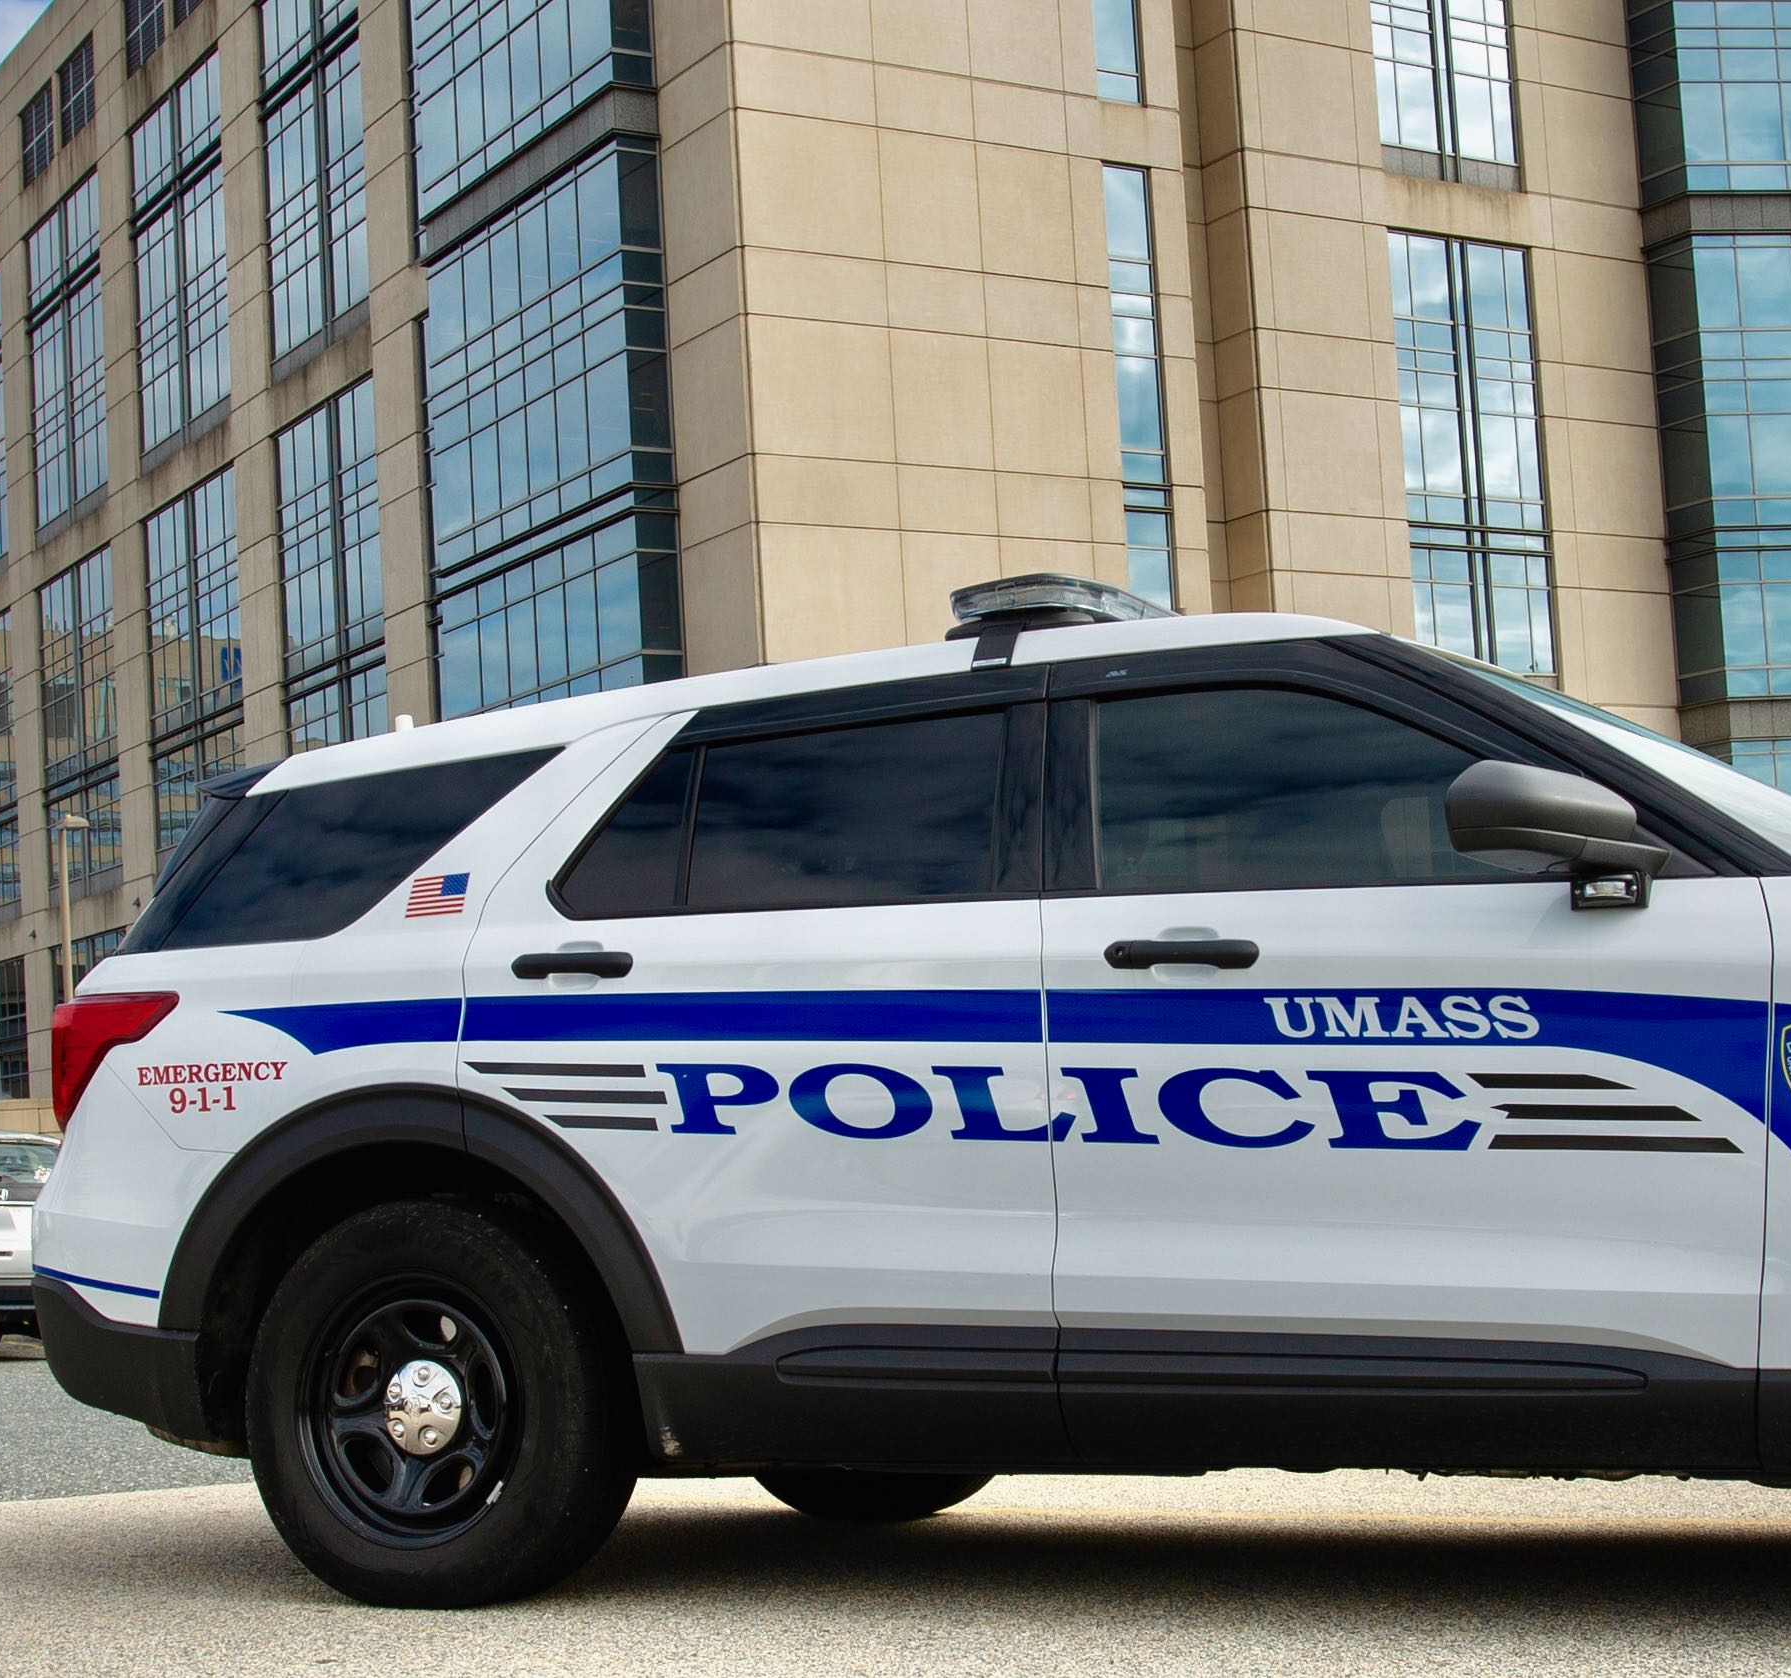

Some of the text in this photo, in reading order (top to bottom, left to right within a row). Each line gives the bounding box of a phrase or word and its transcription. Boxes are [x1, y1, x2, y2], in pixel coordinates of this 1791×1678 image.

[1263, 995, 1540, 1039] UMASS
[137, 1061, 288, 1086] EMERGENCY
[169, 1086, 236, 1114] 9-1-1
[656, 1062, 1481, 1152] POLICE
